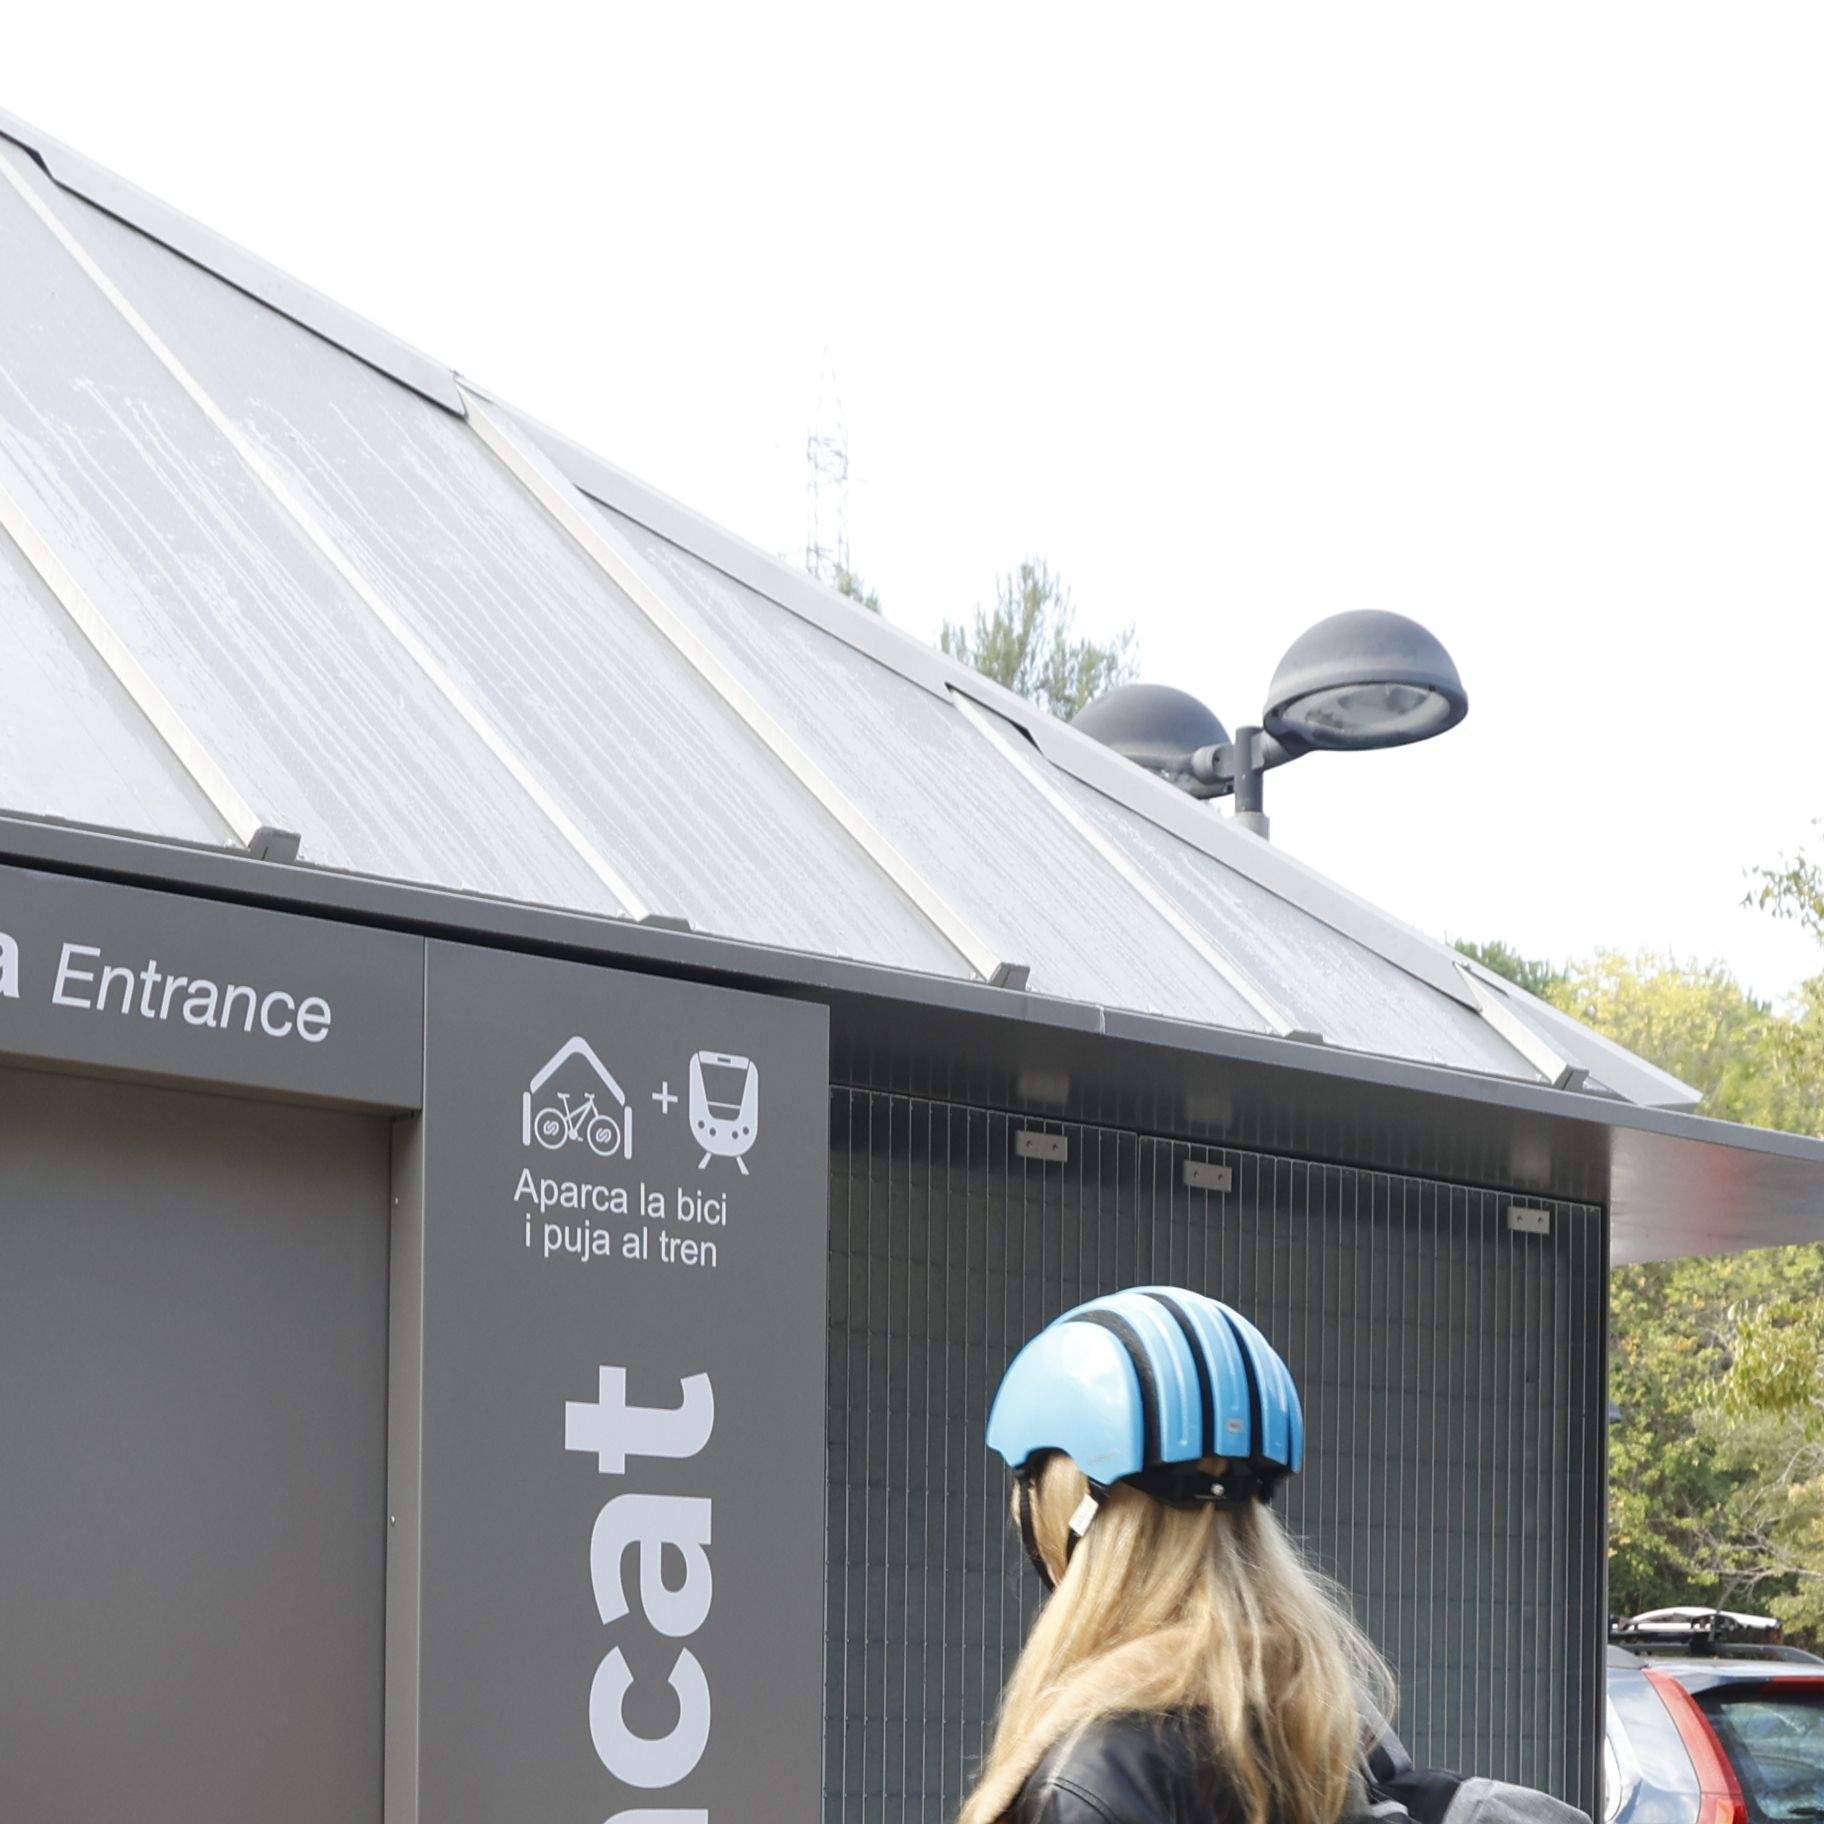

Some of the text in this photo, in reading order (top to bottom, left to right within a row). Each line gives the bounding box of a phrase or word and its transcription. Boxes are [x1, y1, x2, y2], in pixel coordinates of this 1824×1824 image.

[51, 944, 332, 1043] Entrance
[513, 1168, 727, 1226] Aparca la bici
[525, 1213, 717, 1268] i puja al tren
